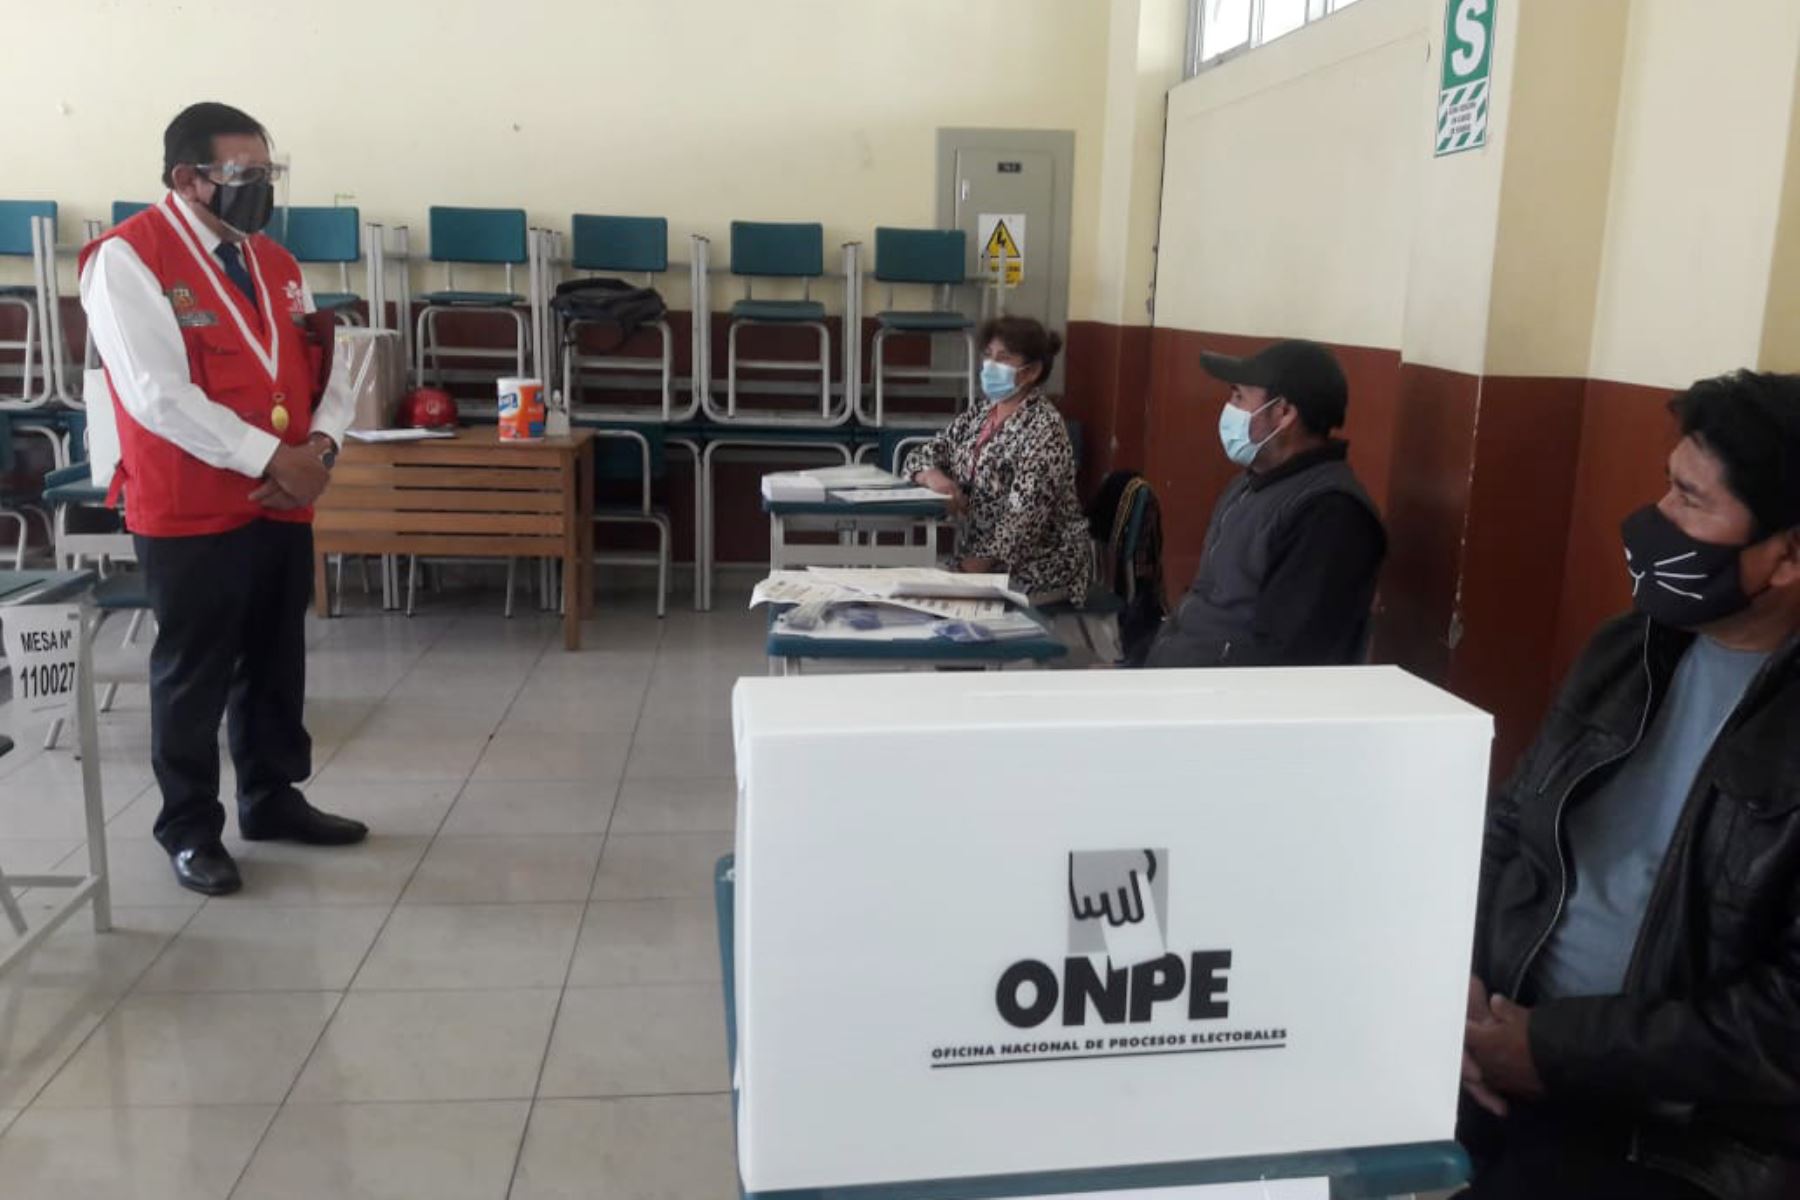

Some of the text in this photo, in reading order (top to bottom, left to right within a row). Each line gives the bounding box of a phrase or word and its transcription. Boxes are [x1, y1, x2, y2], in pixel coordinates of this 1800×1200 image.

[1452, 0, 1487, 76] S
[20, 630, 58, 653] MESA
[20, 662, 75, 698] 110027
[995, 949, 1232, 1029] ONPE
[931, 1028, 1287, 1059] OFICINA NACIONAL DE PROCESOS ELECTORALES
